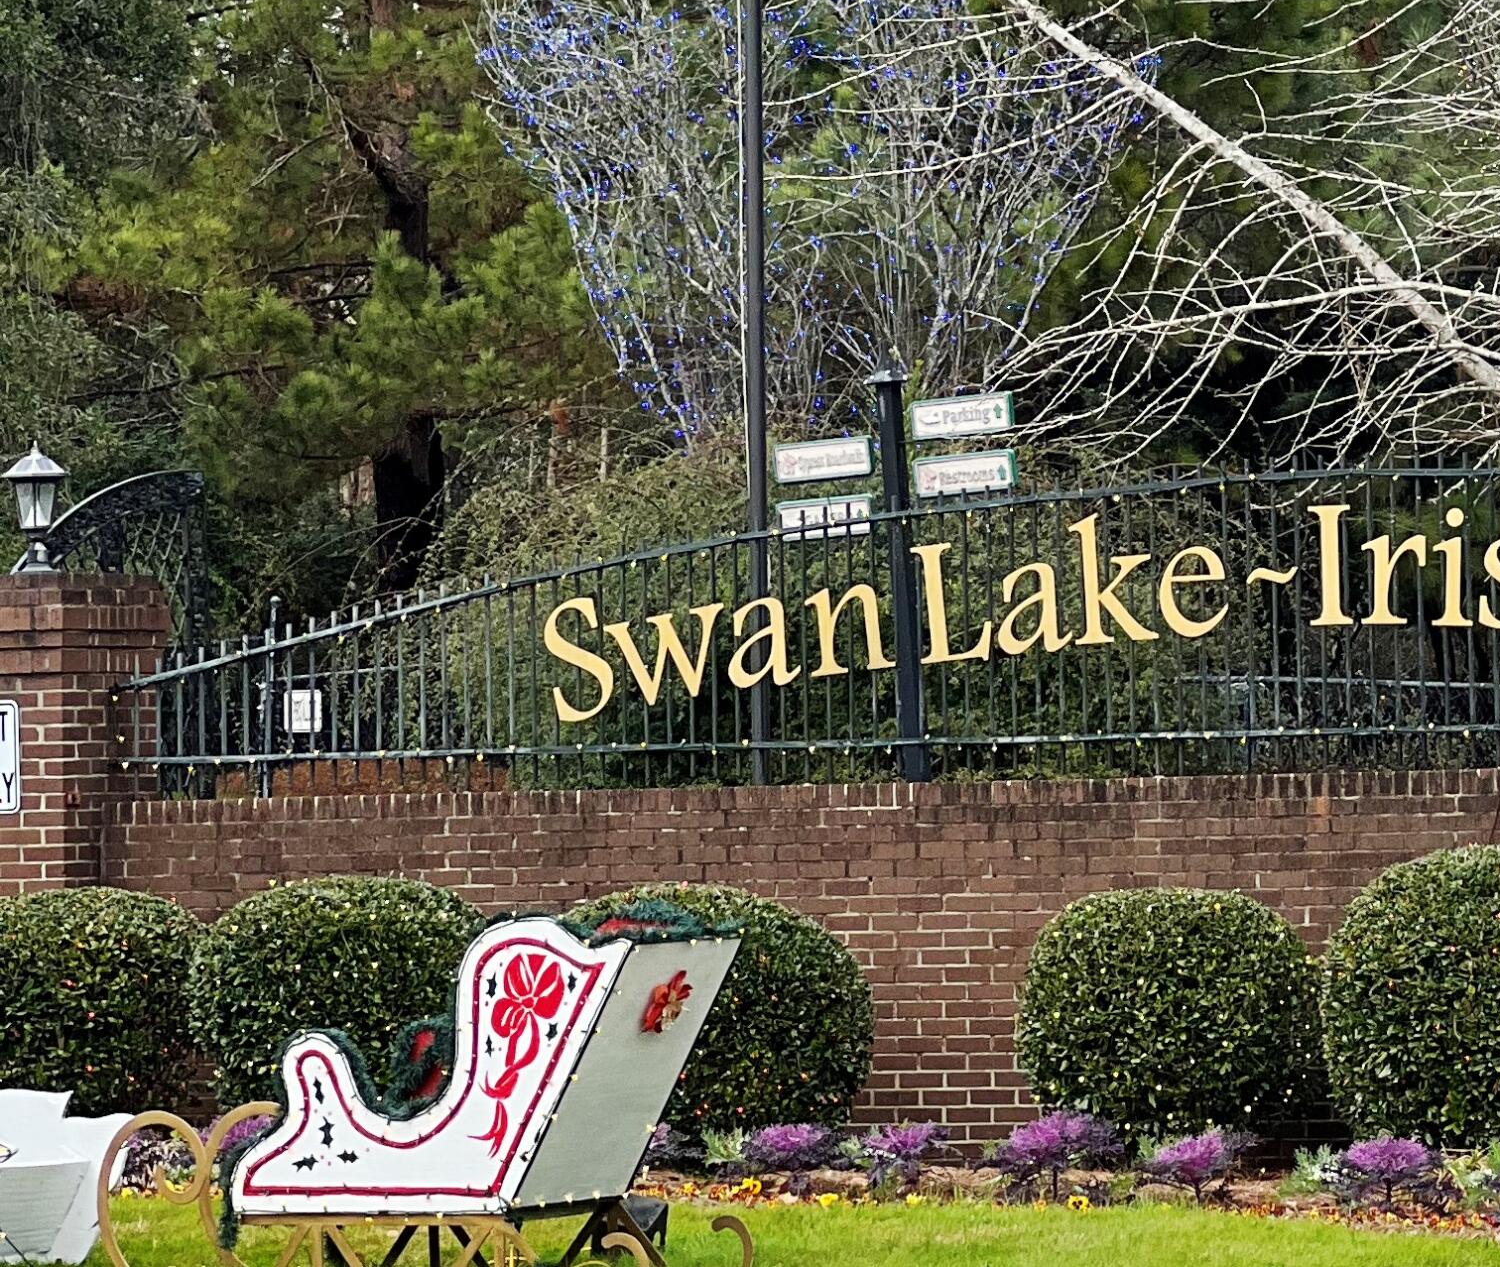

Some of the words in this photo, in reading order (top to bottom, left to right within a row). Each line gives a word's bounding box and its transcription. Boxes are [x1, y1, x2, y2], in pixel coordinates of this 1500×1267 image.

[942, 406, 990, 425] Parking
[543, 583, 897, 723] Swan
[910, 512, 1229, 664] Lake
